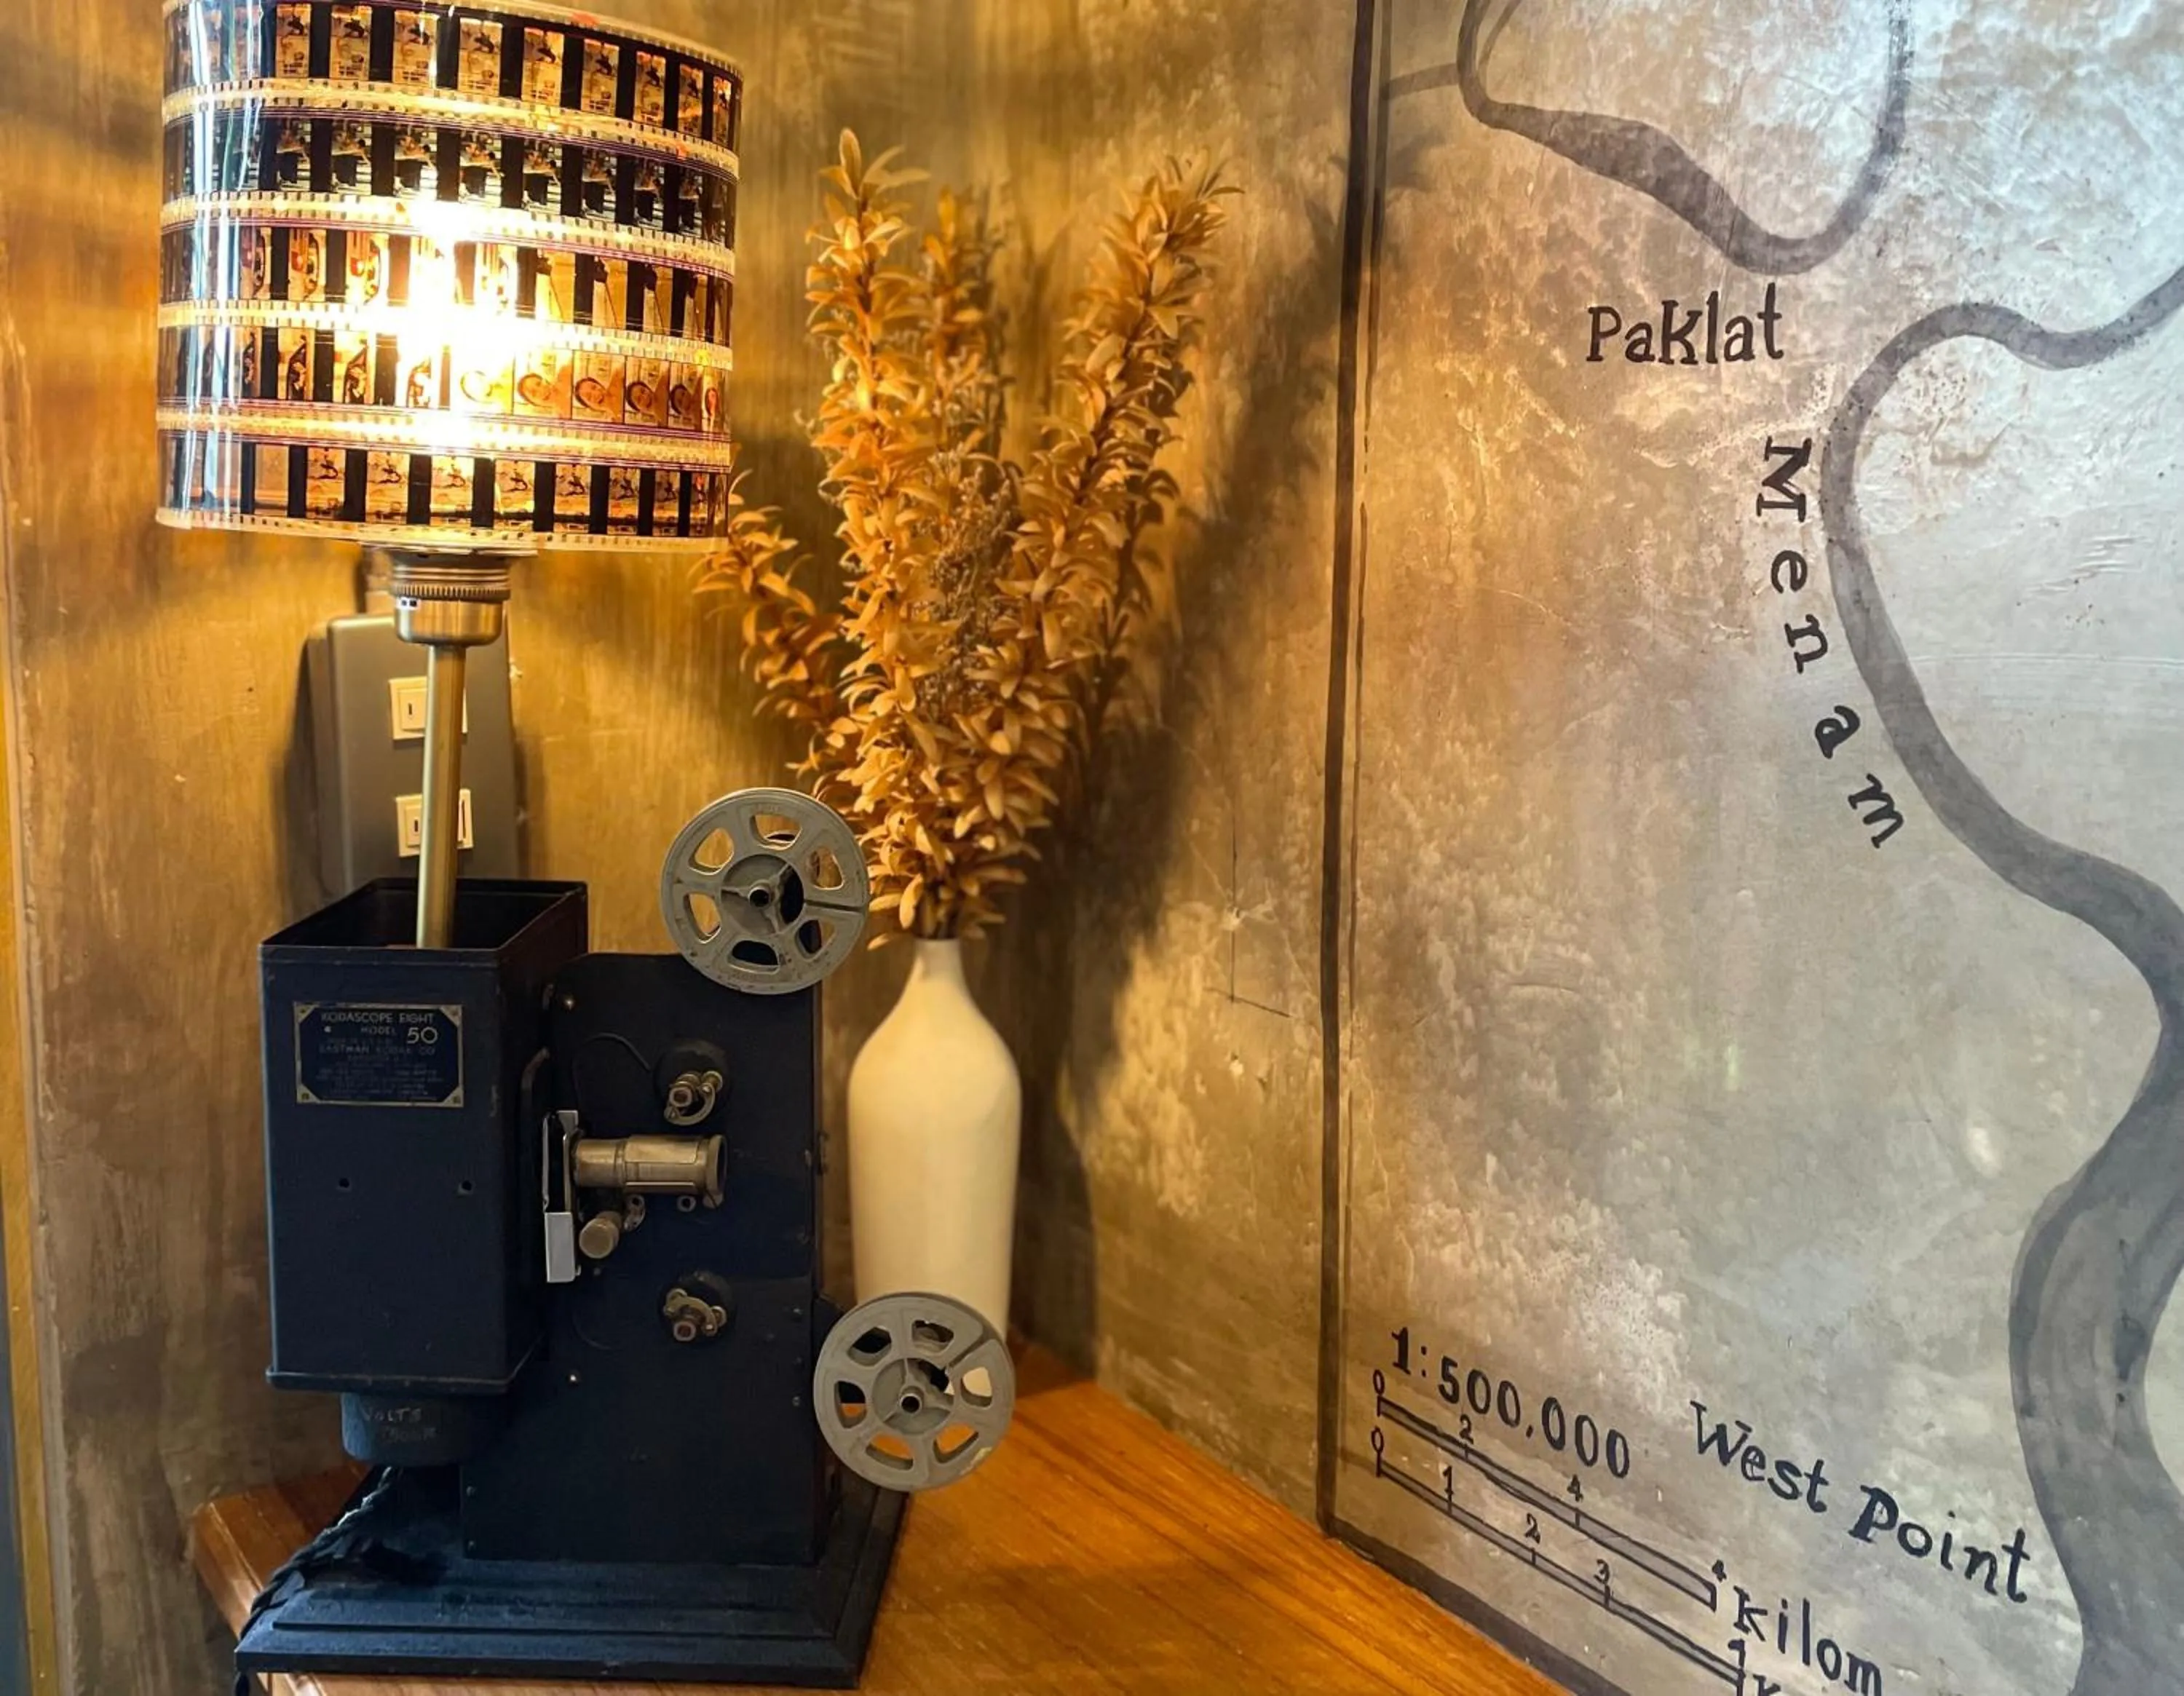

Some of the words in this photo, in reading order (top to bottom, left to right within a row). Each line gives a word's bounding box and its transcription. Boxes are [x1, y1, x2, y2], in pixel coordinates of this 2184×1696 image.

[1756, 436, 1904, 848] Menam
[320, 1012, 394, 1023] KODASCOPE
[399, 1013, 435, 1024] EIGHT
[360, 1026, 397, 1036] MODEL
[406, 1026, 438, 1044] 50
[1690, 1400, 1829, 1513] West
[1848, 1484, 2031, 1604] Point
